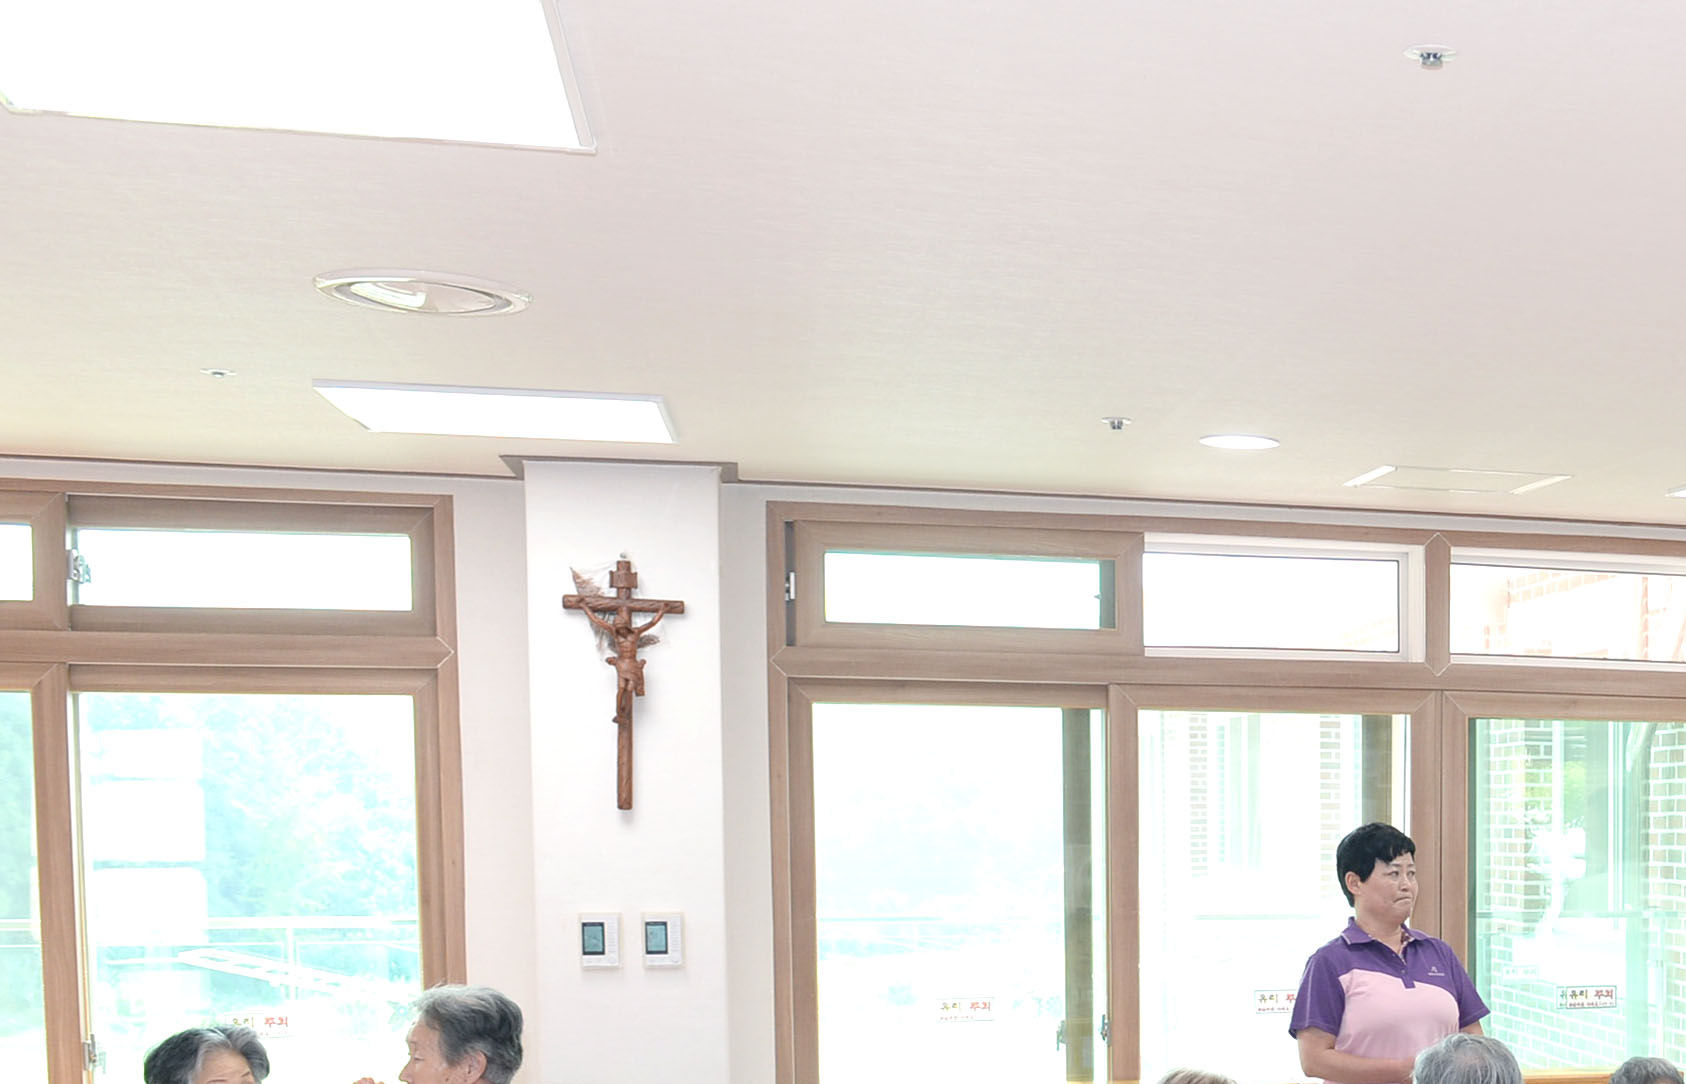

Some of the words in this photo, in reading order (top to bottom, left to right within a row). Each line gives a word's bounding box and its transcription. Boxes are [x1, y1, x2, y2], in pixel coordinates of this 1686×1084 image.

[1258, 993, 1278, 1004] 유리
[1569, 988, 1588, 1000] 유리
[1594, 988, 1614, 1000] 주의
